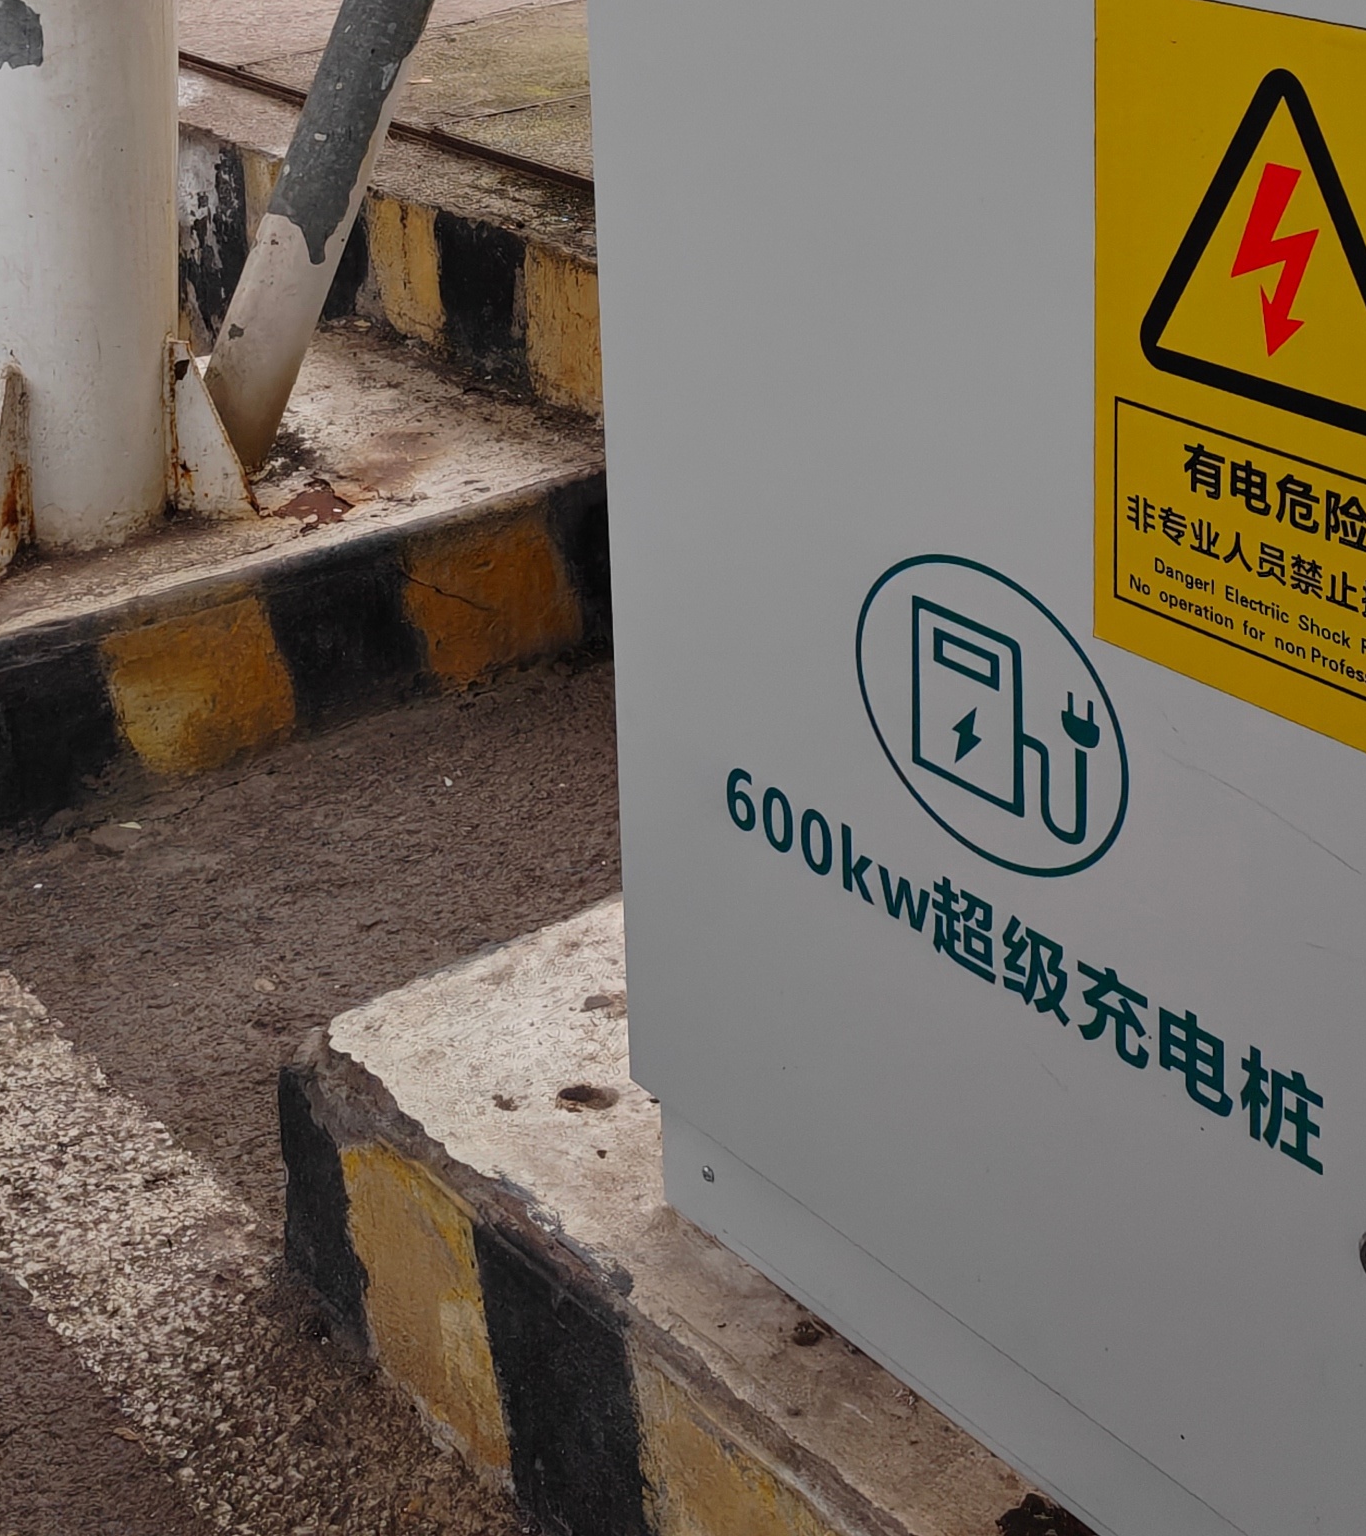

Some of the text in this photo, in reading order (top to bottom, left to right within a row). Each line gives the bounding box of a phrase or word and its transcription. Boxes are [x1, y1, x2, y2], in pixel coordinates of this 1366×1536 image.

[1129, 574, 1151, 596] No
[1159, 590, 1234, 630] operation
[1242, 620, 1266, 642] for
[1274, 635, 1307, 660] non
[1298, 614, 1351, 648] Shock
[726, 767, 1325, 1176] 600kw超级充电桩
